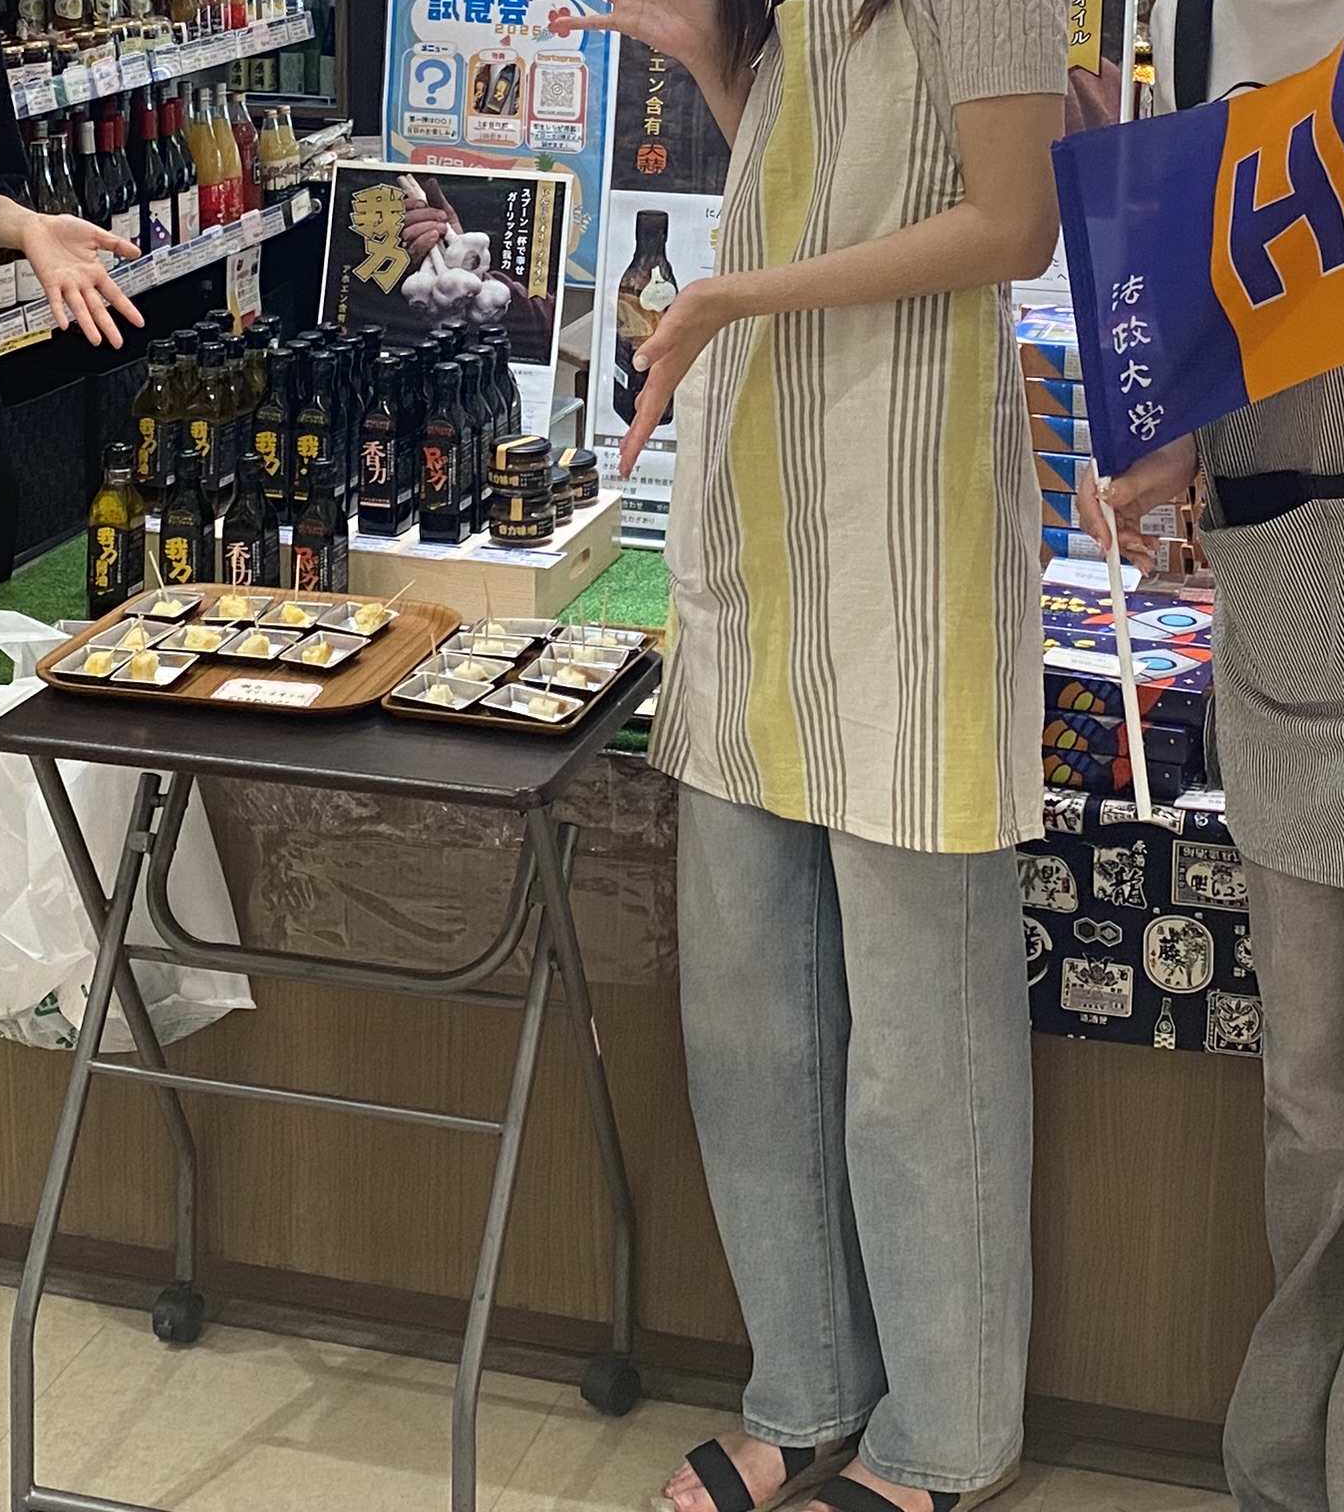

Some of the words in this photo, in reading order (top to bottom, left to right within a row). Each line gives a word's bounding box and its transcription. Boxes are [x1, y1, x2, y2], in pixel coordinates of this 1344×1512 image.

[494, 23, 543, 36] 2025
[348, 183, 411, 295] 我力
[514, 188, 532, 277] スプーン一杯で幸せ
[361, 440, 387, 485] 香力
[163, 536, 193, 584] 我力
[224, 541, 253, 586] 香力
